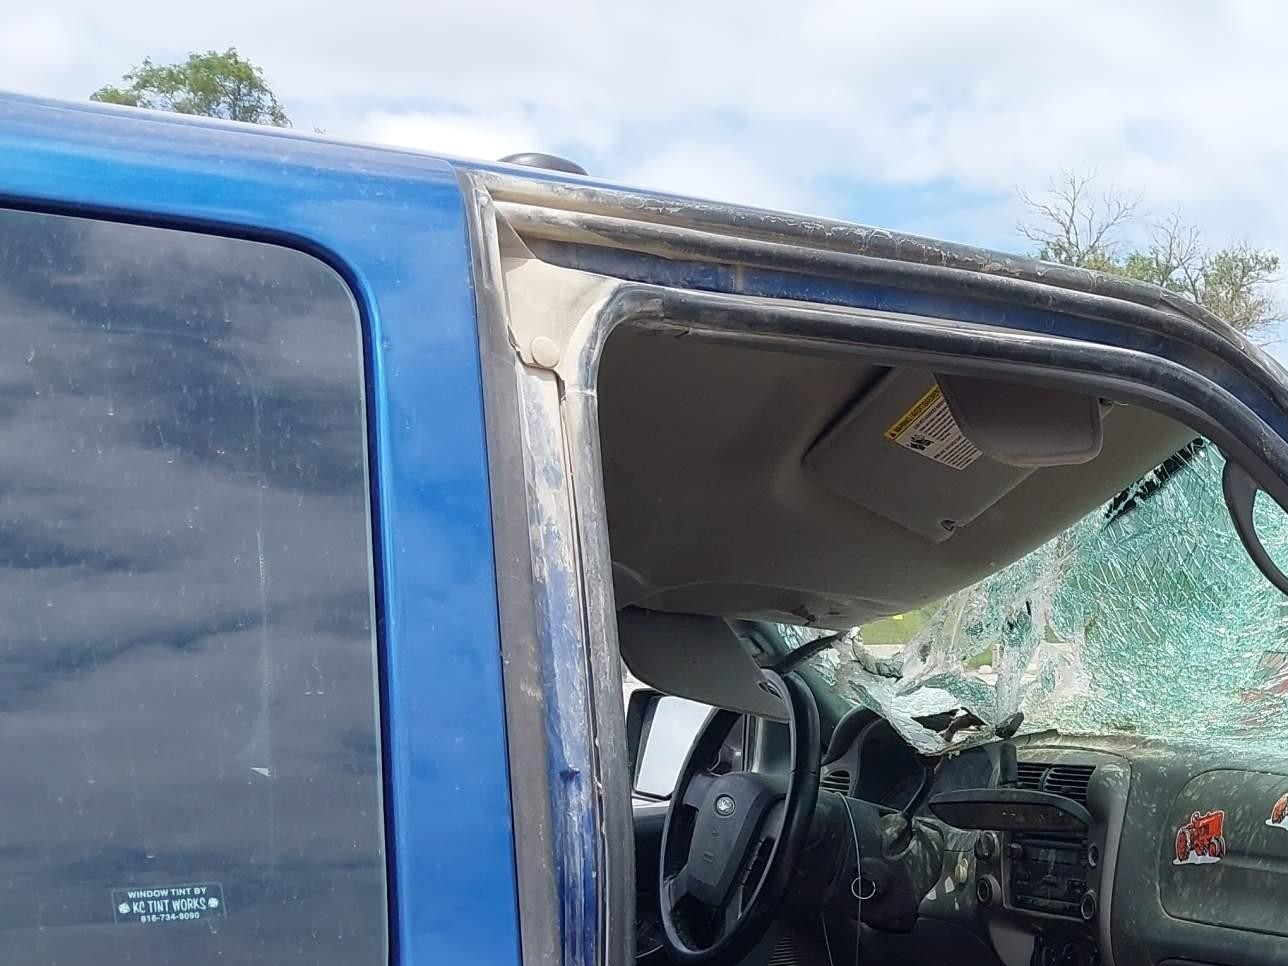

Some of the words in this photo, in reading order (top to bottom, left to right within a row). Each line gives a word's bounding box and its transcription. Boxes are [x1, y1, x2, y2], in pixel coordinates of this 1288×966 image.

[128, 889, 168, 899] WINDOW
[170, 887, 191, 896] TINT
[194, 886, 207, 895] BY
[132, 900, 146, 914] KC
[148, 899, 169, 913] TINT
[172, 897, 207, 912] WORKS
